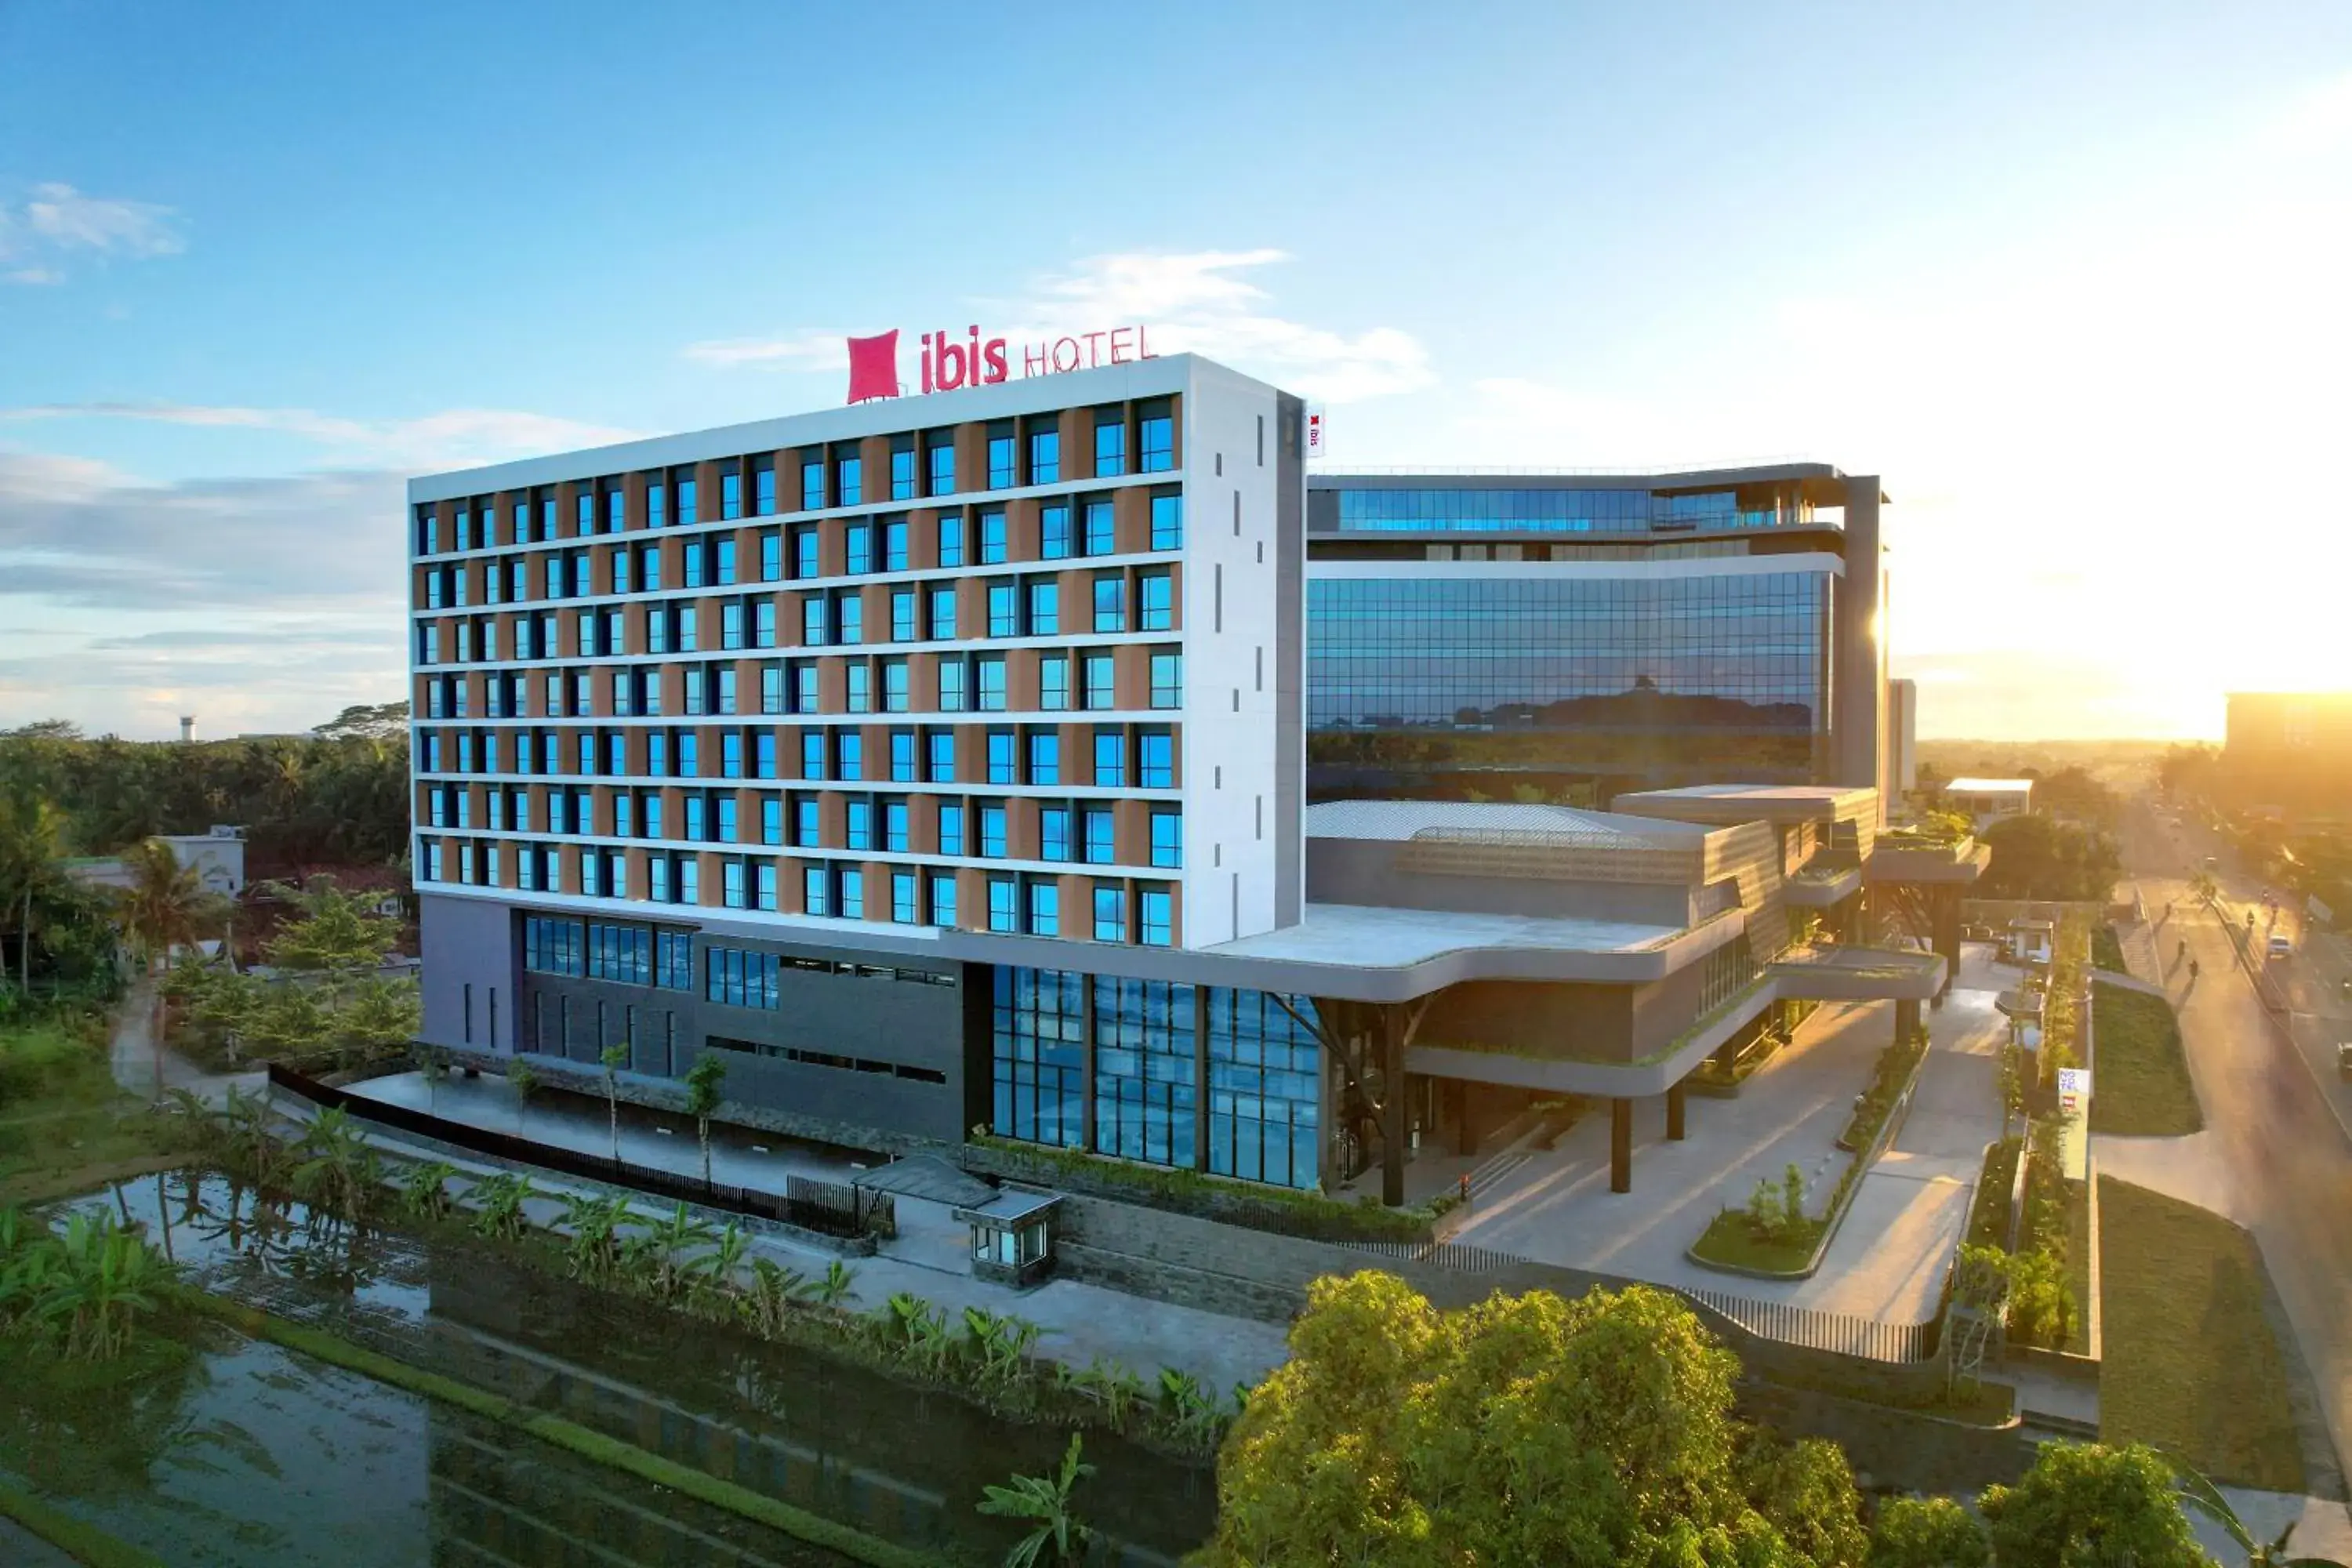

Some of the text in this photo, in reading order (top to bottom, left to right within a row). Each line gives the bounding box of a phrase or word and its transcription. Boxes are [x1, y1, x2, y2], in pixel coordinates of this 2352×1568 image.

[921, 325, 1160, 394] ibis HOTEL
[1310, 429, 1320, 446] ibis
